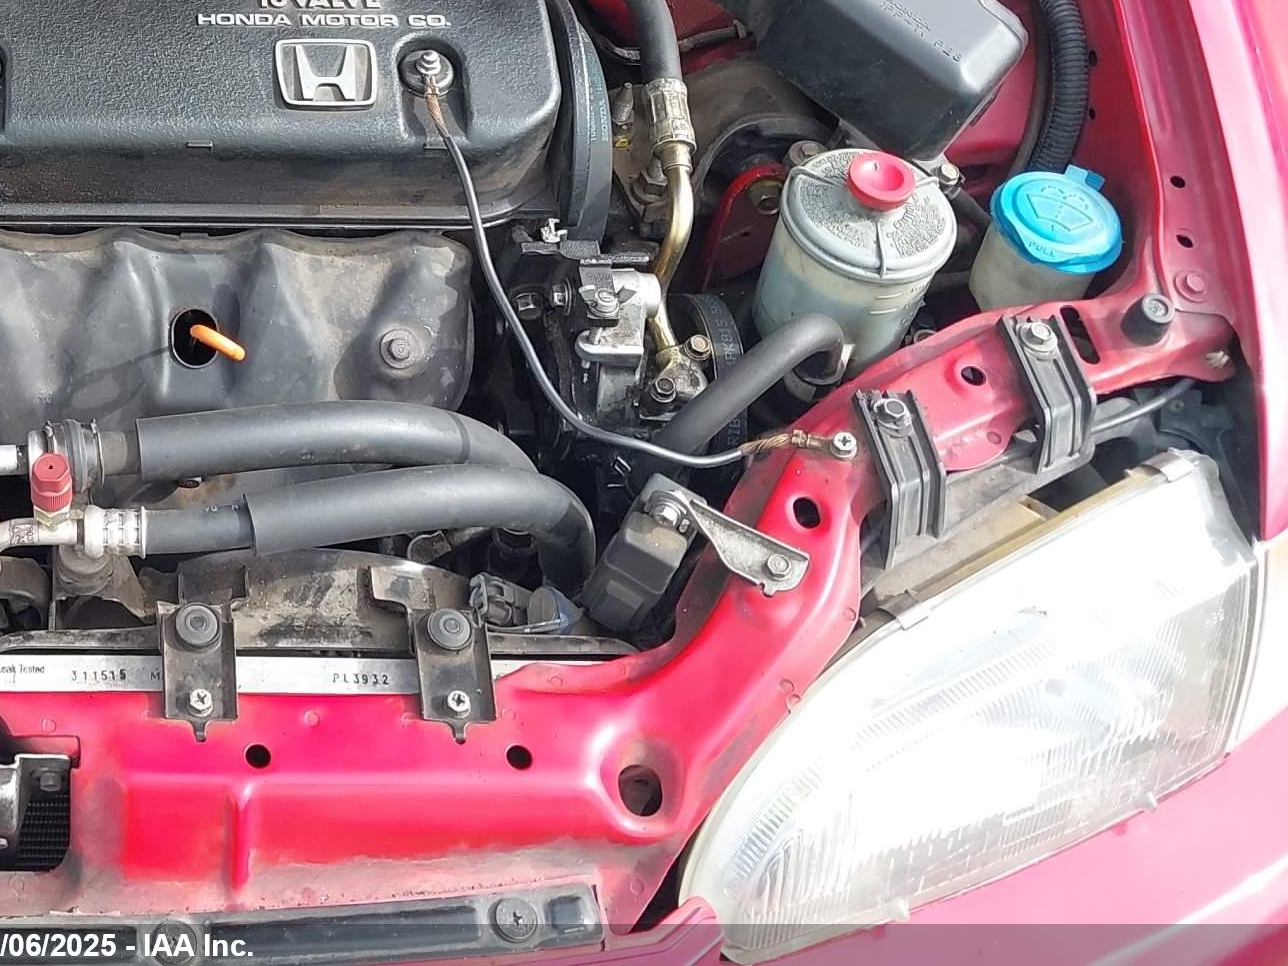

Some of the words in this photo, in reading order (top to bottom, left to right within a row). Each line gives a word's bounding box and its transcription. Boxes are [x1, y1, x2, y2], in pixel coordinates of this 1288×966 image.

[197, 13, 291, 27] HONDA
[302, 13, 399, 27] MOTOR
[408, 14, 452, 27] CO.
[19, 664, 45, 674] Tested
